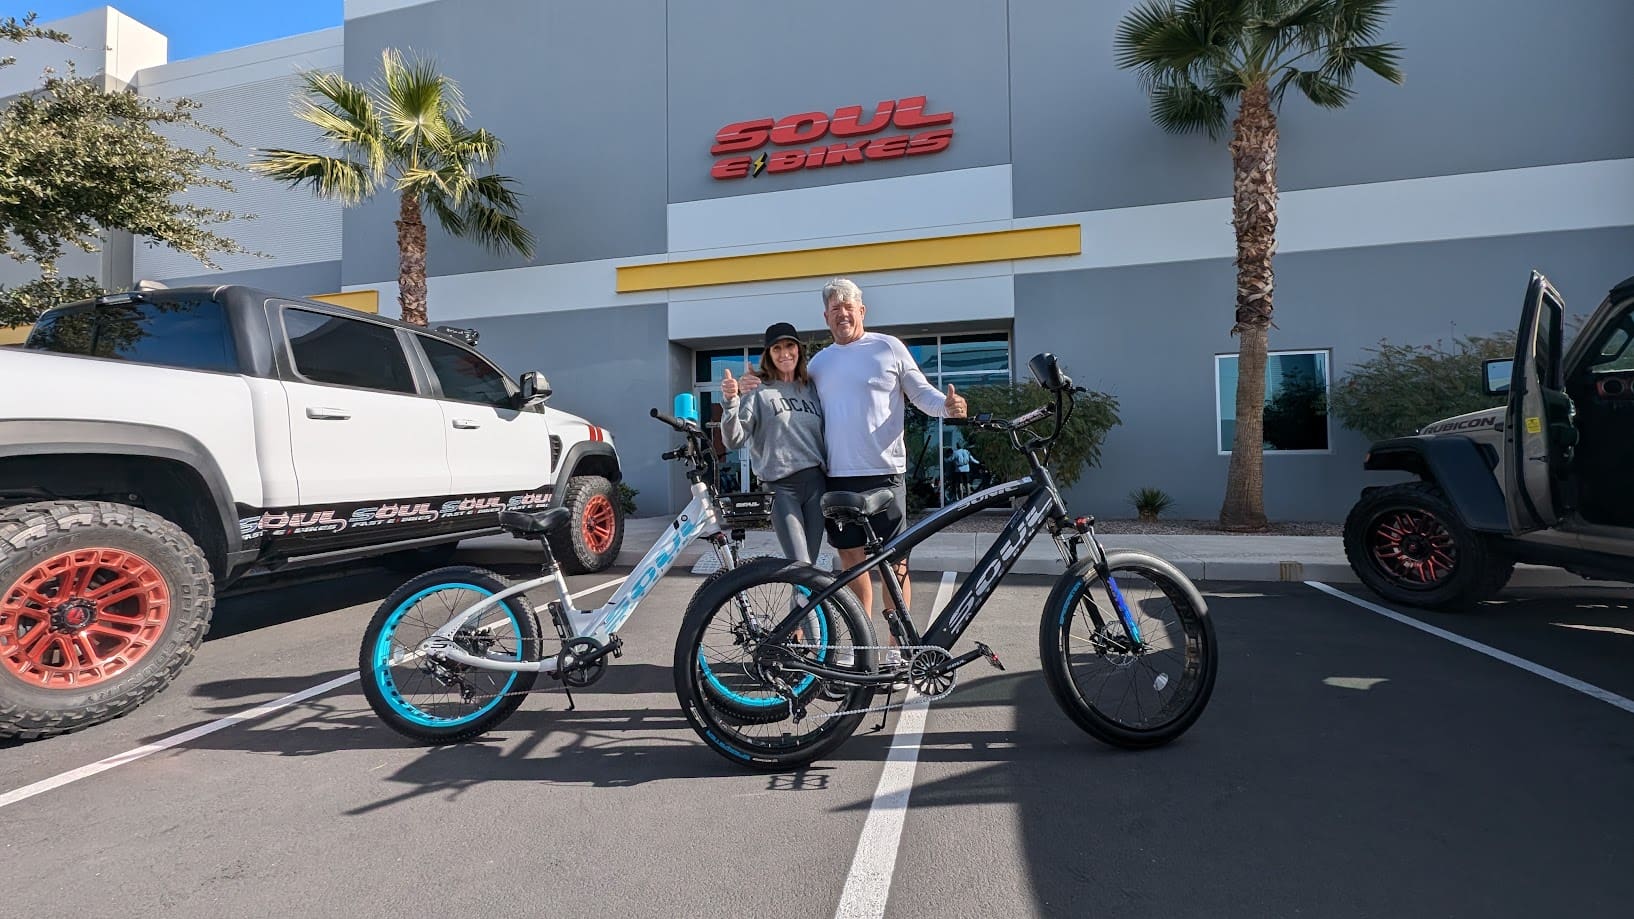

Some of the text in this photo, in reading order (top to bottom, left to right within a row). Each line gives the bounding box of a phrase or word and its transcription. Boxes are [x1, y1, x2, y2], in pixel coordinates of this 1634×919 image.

[711, 95, 954, 156] SOUL
[770, 397, 822, 417] LOCAL
[1424, 416, 1497, 434] RUBICON
[348, 503, 439, 522] SOUL
[439, 496, 507, 514] SOUL
[239, 510, 348, 535] SOUL
[604, 514, 703, 633] SOUL
[949, 497, 1052, 634] SOUL
